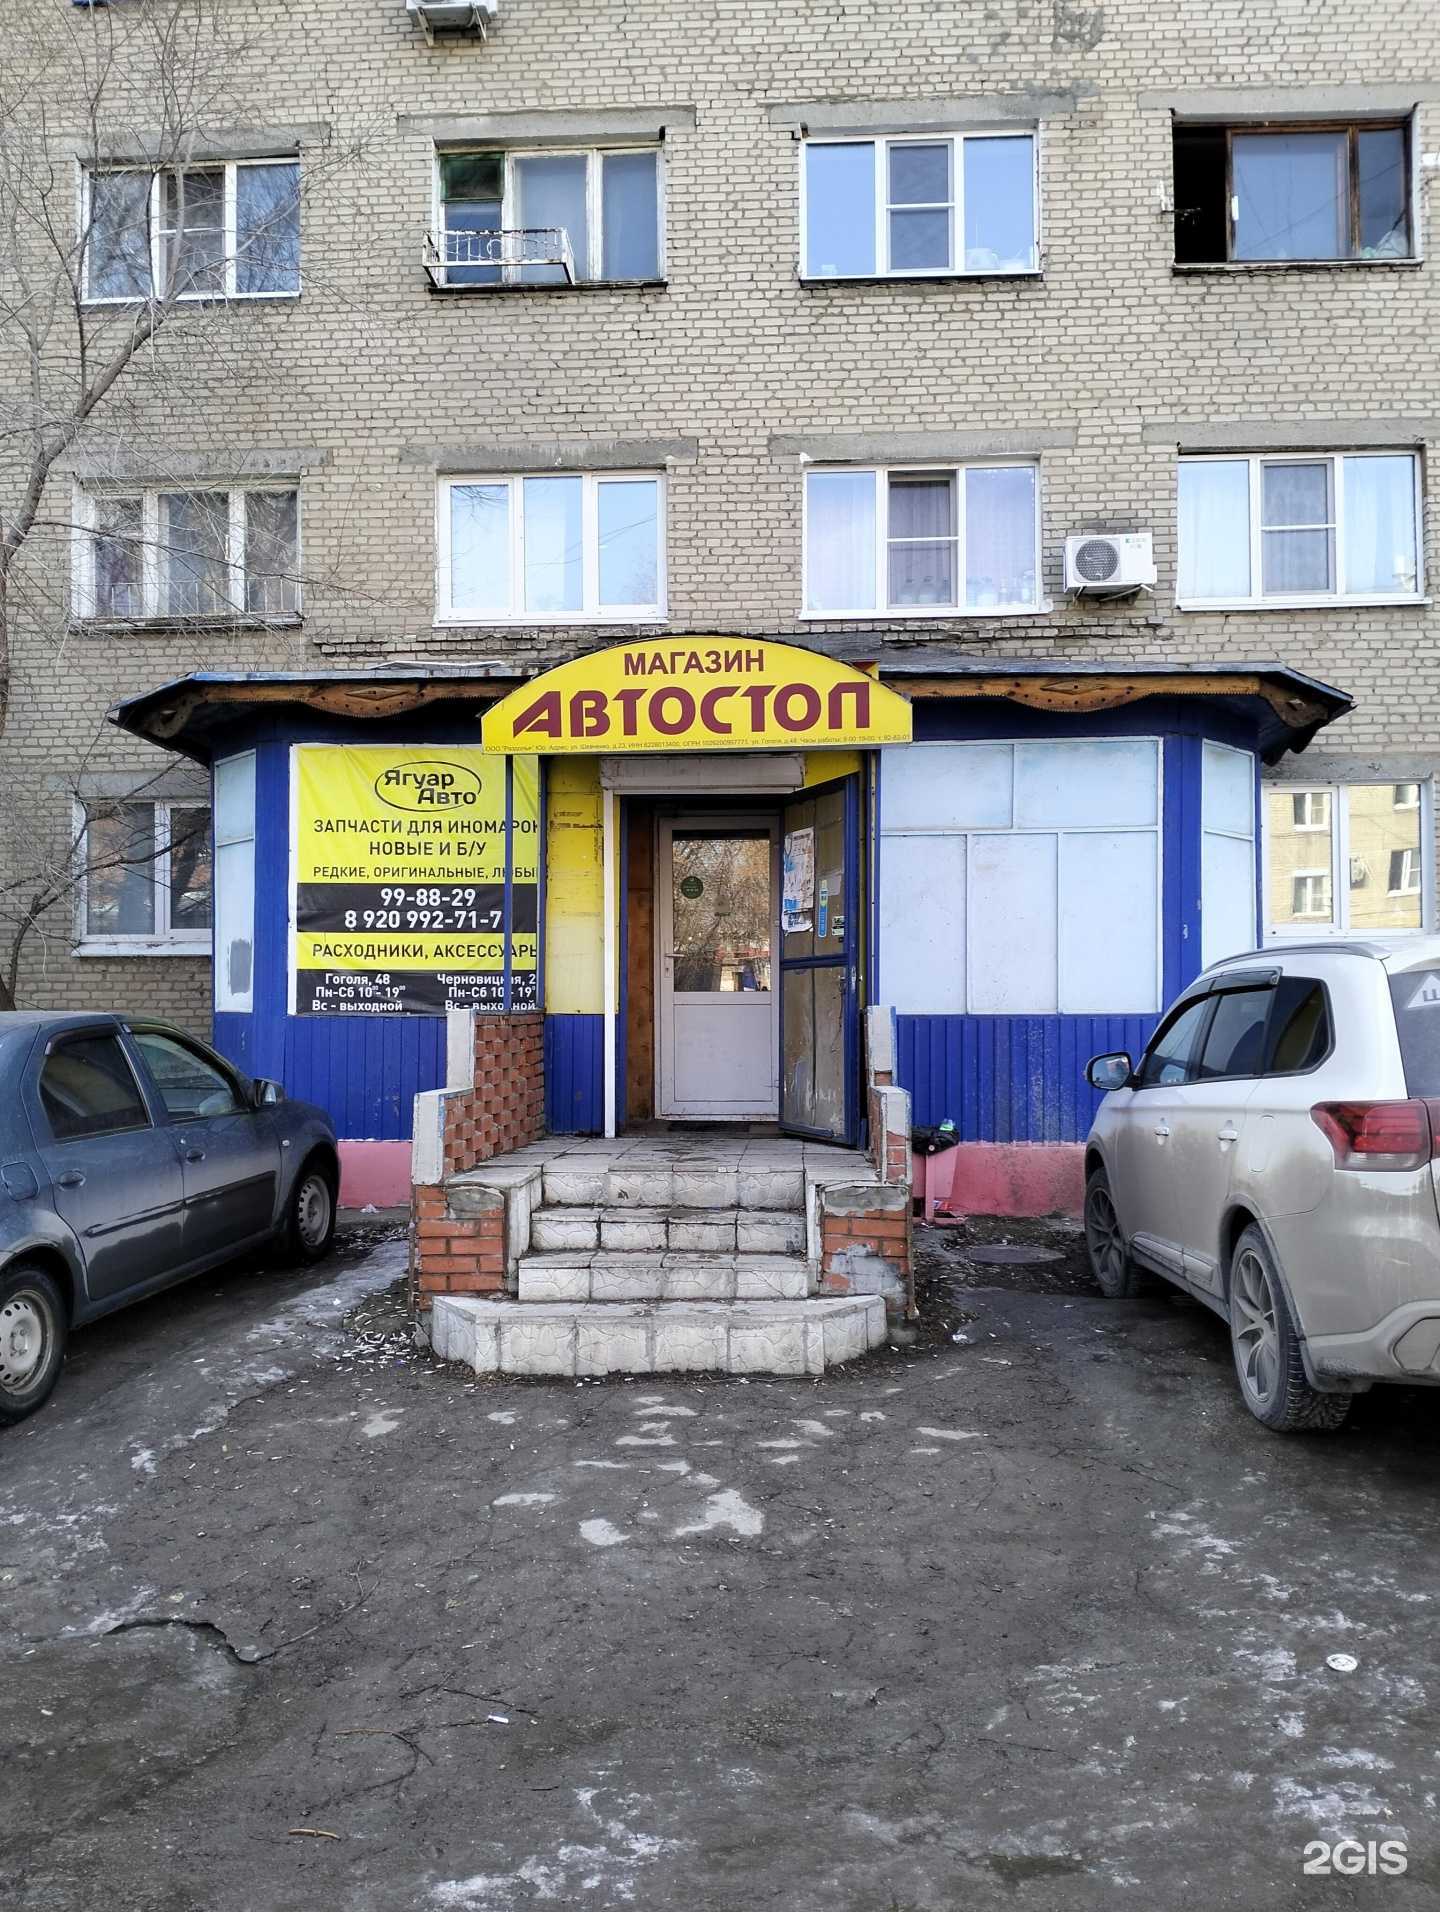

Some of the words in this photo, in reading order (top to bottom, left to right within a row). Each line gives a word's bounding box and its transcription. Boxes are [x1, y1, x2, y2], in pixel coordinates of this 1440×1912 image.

[624, 649, 764, 675] МАГАЗИН
[513, 682, 870, 738] АВТОСТОП
[384, 770, 455, 789] Ягуар
[417, 788, 477, 805] Авто
[314, 819, 402, 834] ЗАПЧАСТИ
[407, 819, 442, 836] ДЛЯ
[370, 841, 433, 856] НОВЫЕ
[439, 841, 451, 856] И
[457, 841, 487, 857] Б/У
[313, 866, 370, 879] РЕДКИЕ,
[374, 866, 489, 879] ОРИГИНАЛЬНЫЕ,
[492, 866, 537, 878] ЛБЫ
[380, 888, 476, 907] 99-88-29
[345, 910, 357, 929] 8
[363, 910, 401, 929] 920
[406, 910, 502, 929] 992-71-7
[312, 944, 429, 960] РАСХОДНИКИ,
[325, 973, 372, 986] Гоголя,
[375, 973, 391, 985] 48
[437, 973, 526, 987] Черновиця,
[316, 986, 354, 998] Пн-Сб
[449, 986, 487, 998] Пн-Сб
[312, 999, 328, 1011] Вс
[340, 1000, 403, 1012] выходной
[445, 999, 460, 1011] Вс
[473, 1000, 536, 1011] выхоной
